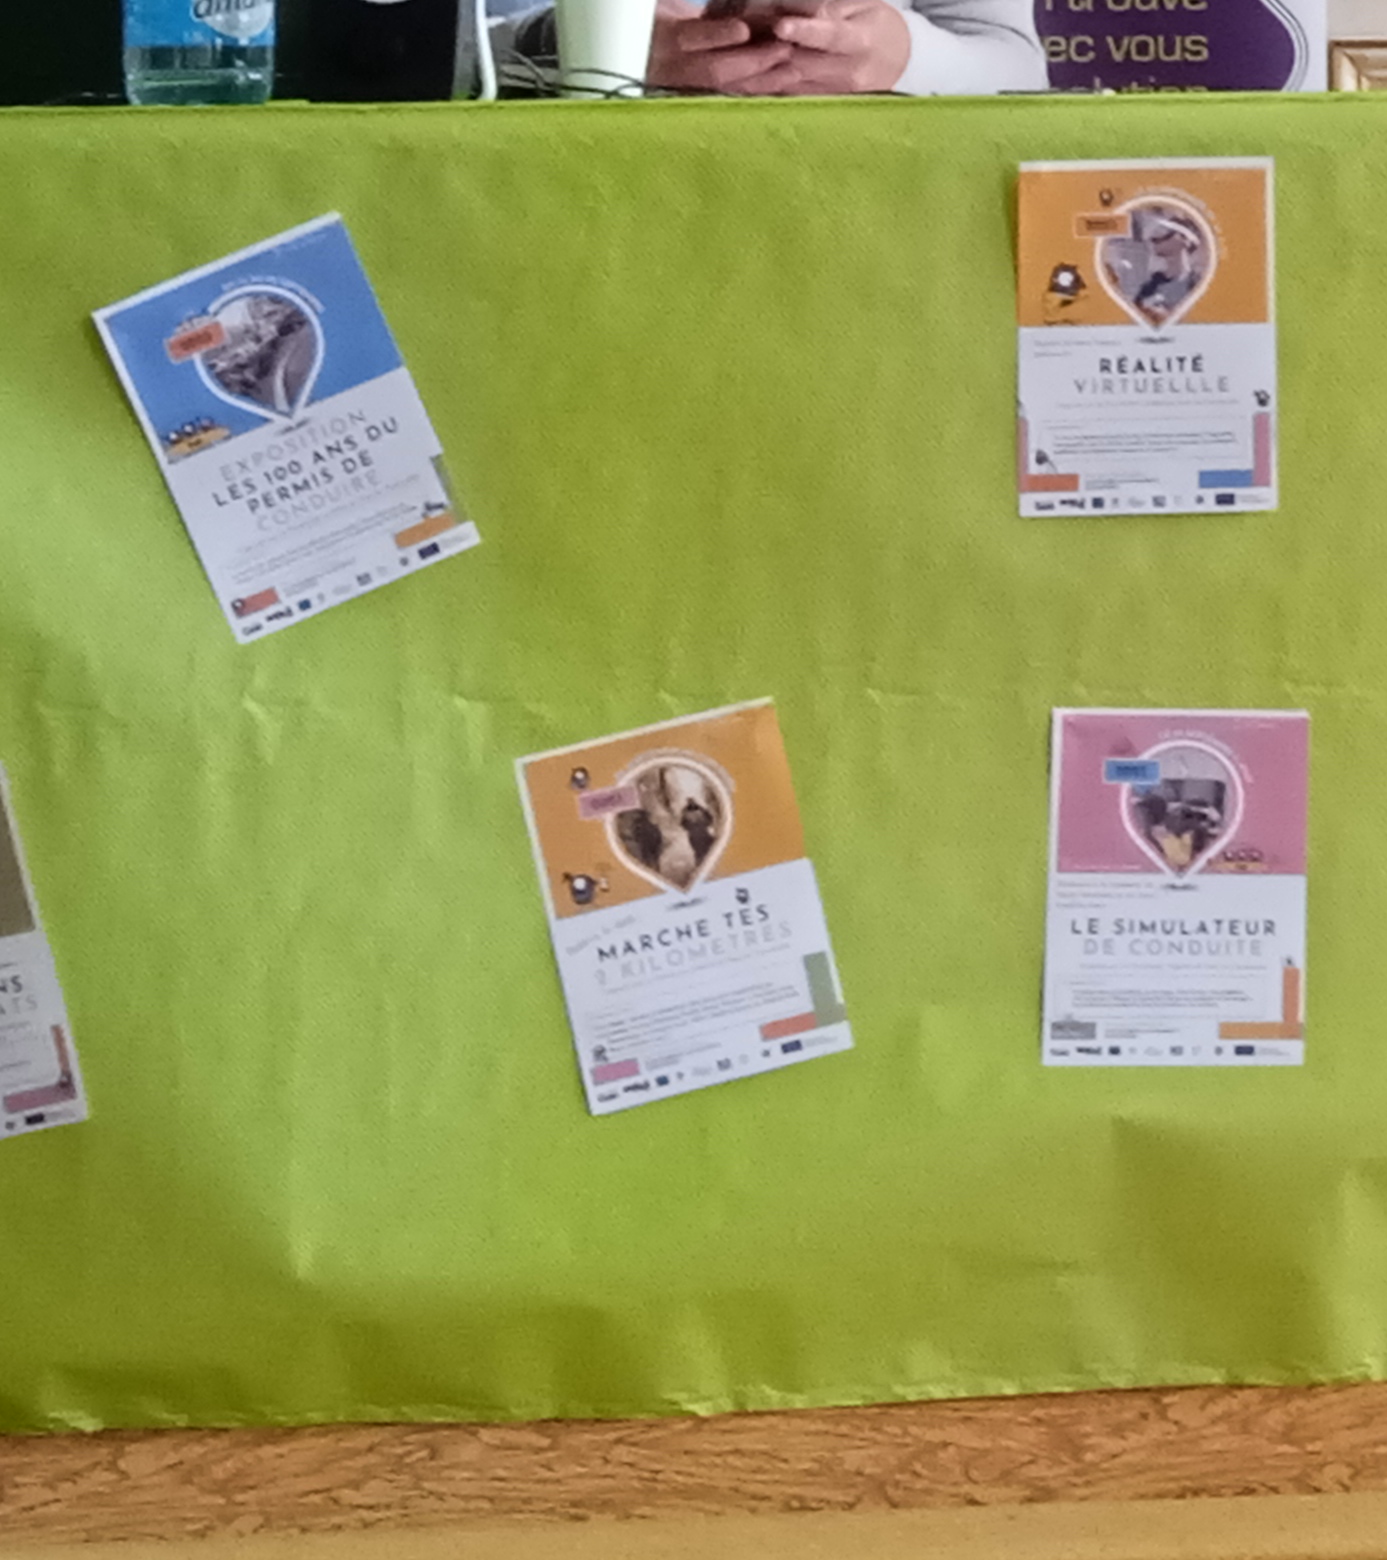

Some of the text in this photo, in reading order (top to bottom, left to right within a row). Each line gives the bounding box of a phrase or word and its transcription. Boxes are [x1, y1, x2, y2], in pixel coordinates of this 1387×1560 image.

[1105, 34, 1210, 62] vous
[1100, 354, 1205, 374] RÉALITÉ
[212, 417, 398, 508] LES 100 ANS DU
[219, 409, 368, 482] EXPOSITION
[247, 449, 375, 515] PERMIS DE
[256, 469, 382, 532] CONDUIRE
[596, 918, 711, 963] MARCHE
[723, 903, 771, 930] TES
[1071, 918, 1277, 937] LE SIMULATEUR
[1083, 939, 1263, 958] DE CONDUITE
